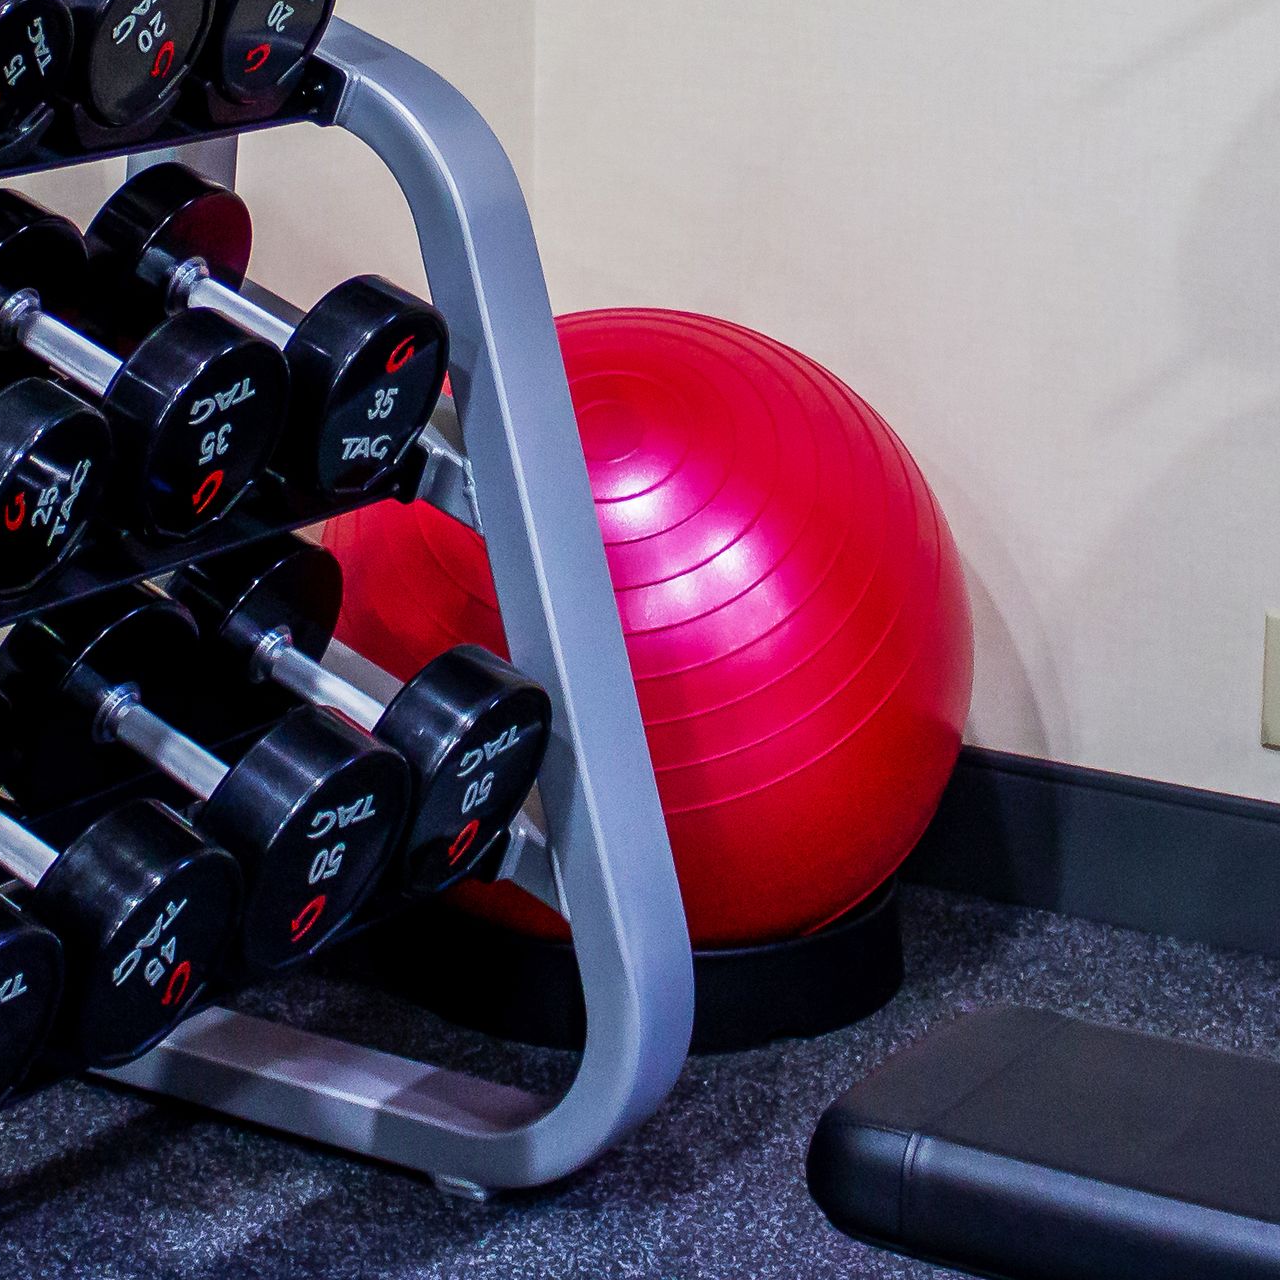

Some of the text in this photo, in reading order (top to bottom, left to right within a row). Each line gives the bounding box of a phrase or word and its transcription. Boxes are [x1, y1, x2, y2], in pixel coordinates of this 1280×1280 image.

[138, 11, 166, 53] 20
[266, 0, 295, 33] 20
[27, 15, 54, 77] TAG
[4, 53, 28, 86] 15
[188, 377, 256, 427] TAG
[367, 387, 399, 422] 35
[199, 423, 231, 465] 35
[340, 435, 394, 461] TAG
[31, 486, 60, 528] 25
[47, 458, 92, 548] TAG
[456, 724, 523, 780] TAG
[460, 771, 493, 815] 50
[306, 793, 377, 842] TAG
[308, 842, 346, 886] 50
[112, 898, 188, 988] TAG
[144, 935, 179, 987] 45
